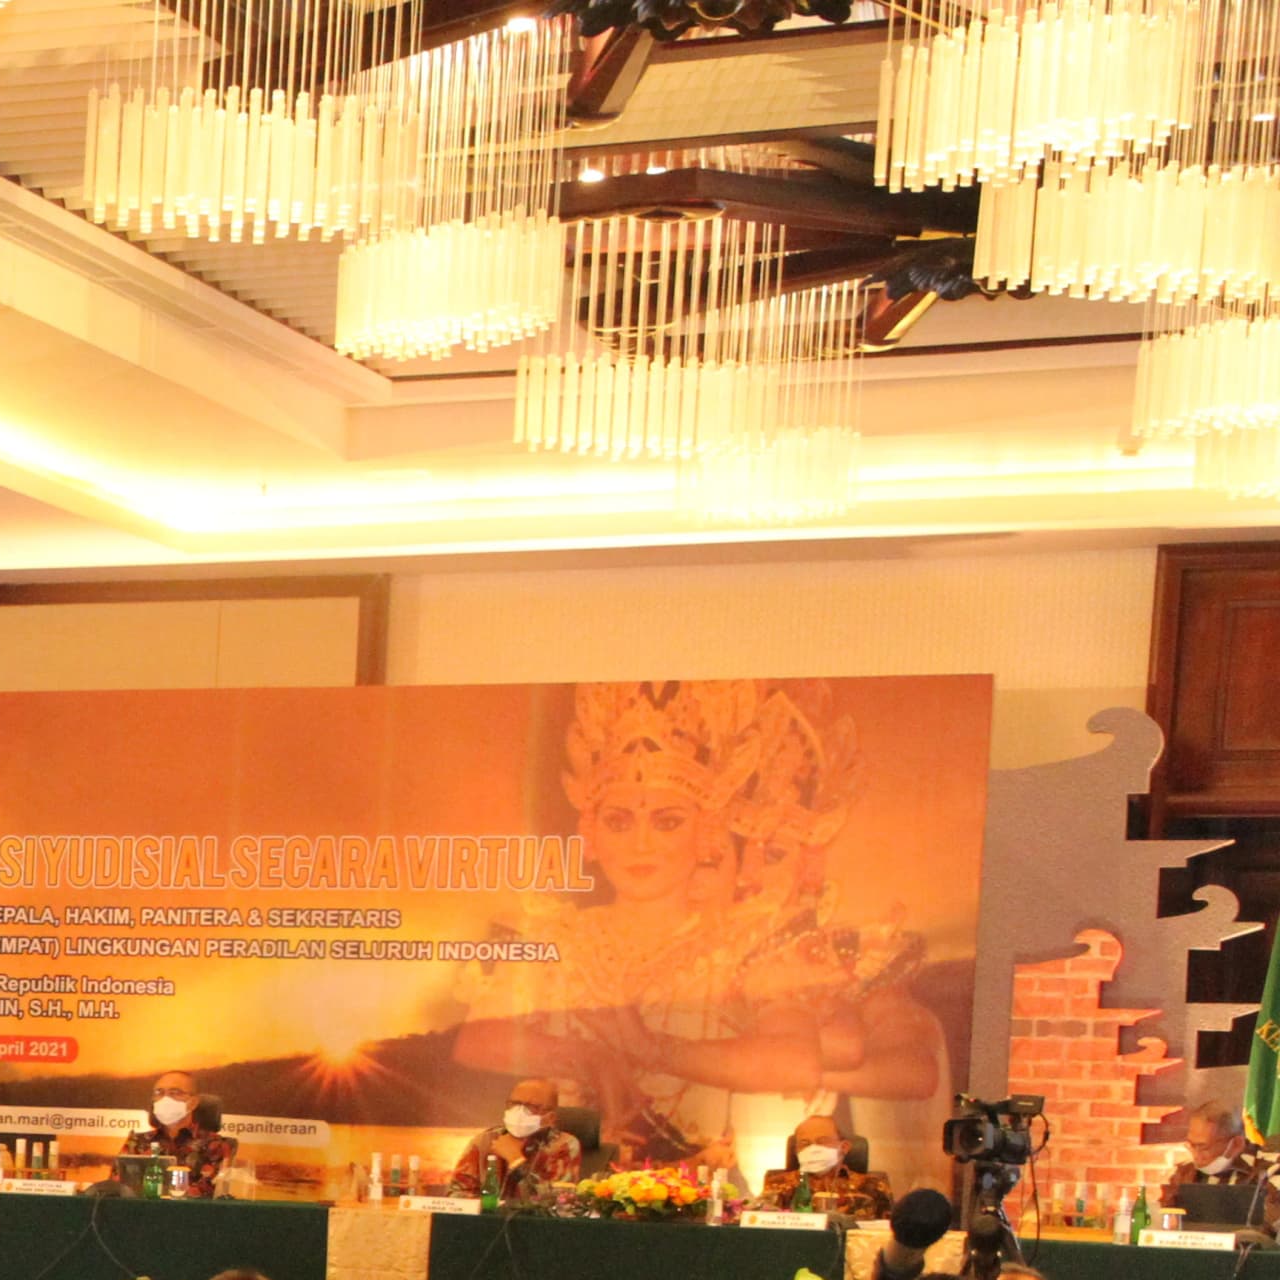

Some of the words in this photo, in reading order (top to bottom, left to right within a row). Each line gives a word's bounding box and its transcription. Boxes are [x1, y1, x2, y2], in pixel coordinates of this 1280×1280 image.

[40, 835, 227, 890] YUDISIAL
[229, 835, 399, 891] SECARA
[403, 835, 595, 892] VIRTUAL
[65, 907, 135, 927] HAKIM,
[140, 908, 242, 926] PANITERA
[247, 909, 262, 927] &
[268, 909, 402, 928] SEKRETARIS
[65, 938, 200, 957] LINGKUNGAN
[206, 939, 326, 959] PERADILAN
[331, 940, 432, 960] SELURUH
[437, 942, 560, 961] INDONESIA
[81, 976, 175, 995] Indonesia
[29, 999, 73, 1020] S.H.,
[78, 1001, 120, 1019] M.H.
[30, 1042, 69, 1057] 2021
